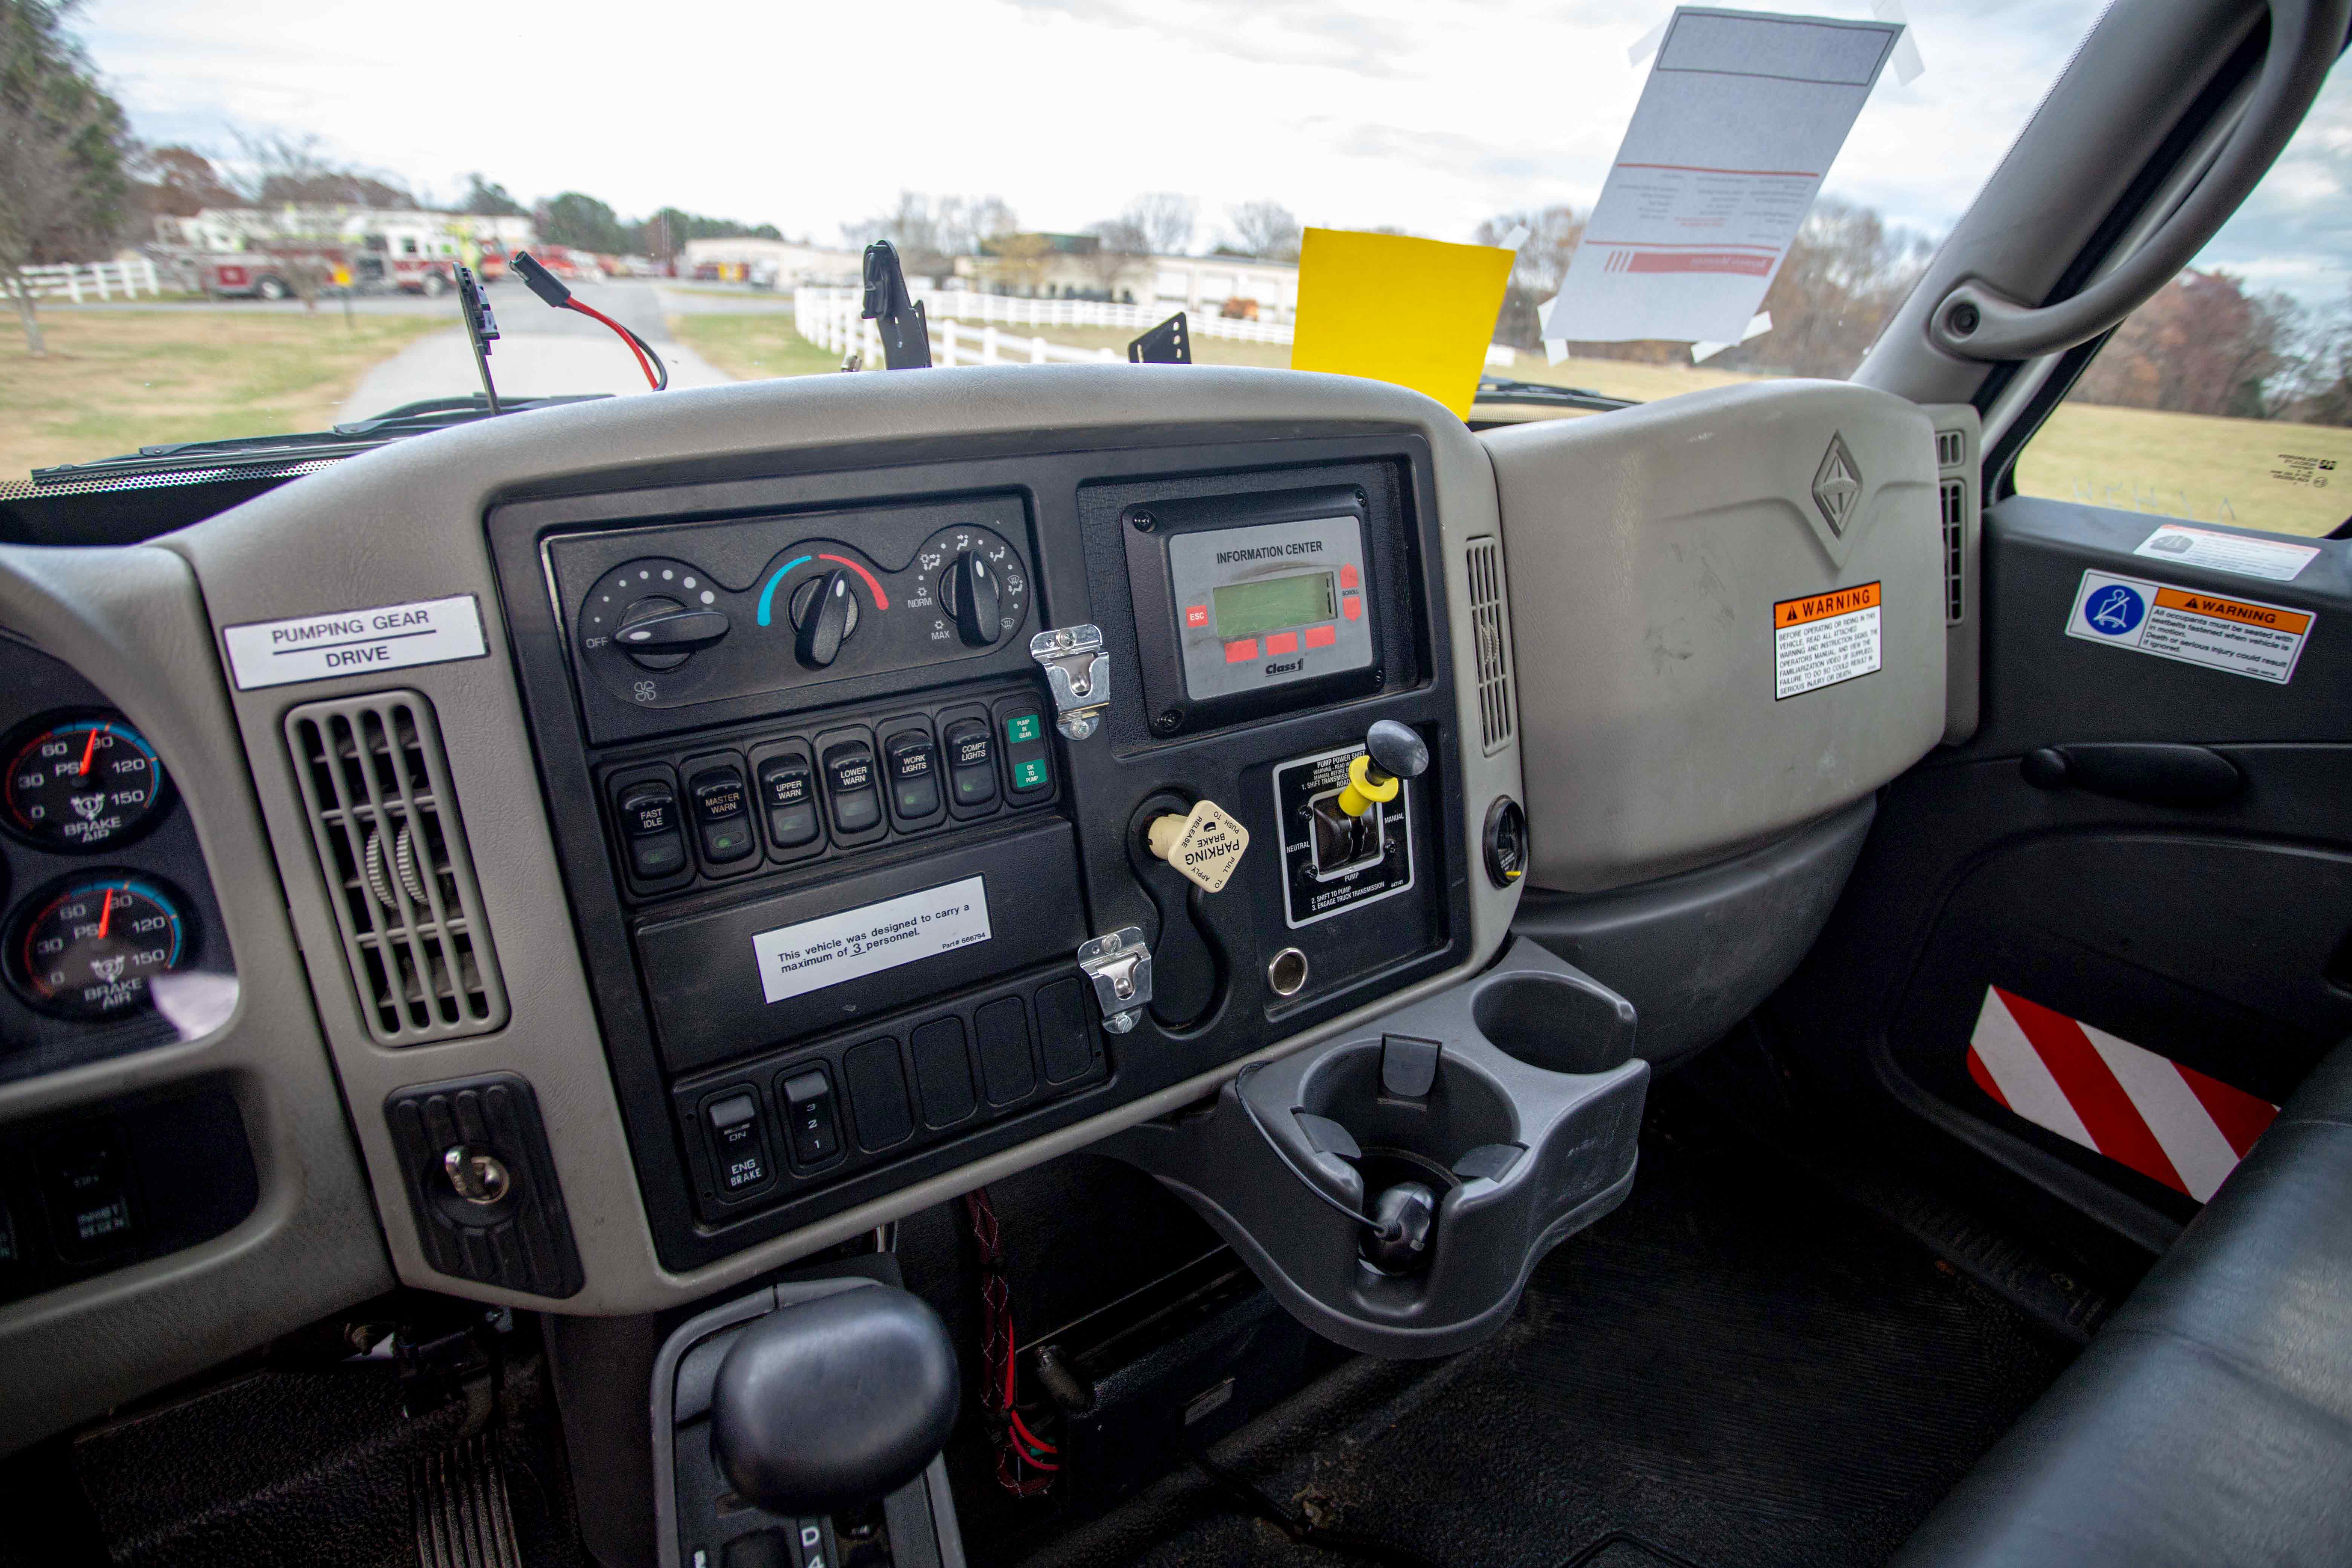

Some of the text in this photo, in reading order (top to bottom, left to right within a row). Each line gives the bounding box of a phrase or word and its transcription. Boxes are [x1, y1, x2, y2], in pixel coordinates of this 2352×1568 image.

[1217, 541, 1322, 564] INFORMATION CENTER
[908, 597, 932, 608] NORM
[1803, 589, 1870, 617] WARNING
[1190, 612, 1204, 620] ESC
[2203, 600, 2277, 623] WARNING
[272, 610, 429, 644] PUMPING GEAR
[1779, 630, 1801, 641] BEFORE
[1804, 623, 1833, 636] OPERATING
[1844, 616, 1858, 625] RIDING
[2151, 617, 2186, 629] seatbelts
[2188, 624, 2222, 637] fastened
[2225, 633, 2247, 642] when
[2249, 637, 2279, 649] vehicle
[2158, 626, 2186, 637] motion.
[2166, 612, 2207, 626] occupants
[2209, 621, 2230, 630] must
[2244, 628, 2273, 639] seated
[2275, 634, 2294, 643] with
[586, 637, 607, 648] OFF
[931, 630, 949, 640] MAX
[1807, 635, 1821, 644] READ
[1833, 626, 1857, 636] ATTACHED
[1779, 648, 1805, 659] WARNING
[1807, 643, 1818, 652] AND
[1820, 635, 1852, 649] INSTRUCTION
[2145, 631, 2168, 642] Death
[2180, 640, 2209, 651] serious
[2211, 646, 2235, 658] injury
[2236, 652, 2260, 663] could
[2262, 657, 2288, 668] result
[2150, 641, 2181, 652] ignored.
[326, 646, 390, 668] DRIVE
[1779, 660, 1825, 677] FAMILIARIZATION
[1826, 655, 1841, 665] VIDEO
[1779, 675, 1802, 686] FAILURE
[1832, 662, 1848, 672] COULD
[1850, 657, 1867, 666] RESULT
[1780, 683, 1804, 695] SERIOUS
[1807, 677, 1825, 688] INJURY
[42, 742, 68, 756] 60
[962, 742, 986, 753] COMPT
[903, 754, 925, 765] WORK
[962, 750, 986, 761] LIGHTS
[1317, 759, 1332, 769] PUMP
[1333, 755, 1351, 765] POWER
[113, 759, 146, 773] 120
[841, 766, 867, 778] LOWER
[902, 763, 926, 773] LIGHTS
[1313, 766, 1332, 775] WARNING
[18, 773, 44, 789] 30
[776, 781, 802, 792] UPPER
[843, 775, 865, 786] WARN
[1307, 780, 1320, 789] SHIFT
[111, 790, 145, 805] 150
[706, 793, 740, 807] MASTER
[778, 789, 801, 799] WARN
[31, 805, 45, 819] 0
[641, 808, 662, 820] FAST
[711, 802, 736, 814] WARN
[643, 818, 663, 828] IDLE
[1384, 813, 1404, 824] MANUAL
[64, 816, 122, 837] BRAKE
[1182, 811, 1240, 848] PUSH TO RELEASE
[83, 829, 110, 843] AIR
[1197, 833, 1225, 848] BRAKE
[1185, 839, 1240, 865] PARKING
[1286, 841, 1310, 853] NEUTRAL
[1191, 856, 1235, 888] PULL TO APPLY
[1344, 872, 1359, 882] PUMP
[1317, 891, 1330, 903] SHIFT
[1338, 886, 1351, 896] PUMP
[1317, 898, 1336, 909] ENGAGE
[1337, 893, 1352, 904] TRUCK
[1352, 881, 1384, 900] TRANSMISSION
[132, 916, 165, 933] 120
[778, 951, 800, 963] This
[805, 939, 842, 955] vehicle
[846, 933, 867, 944] was
[871, 917, 917, 938] designed
[921, 914, 931, 923] to
[935, 906, 960, 920] carry
[942, 932, 986, 950] Part# 666794
[132, 949, 165, 966] 150
[781, 928, 920, 974] maximum of 3 personnel.
[51, 971, 65, 986] 0
[83, 977, 142, 1002] BRAKE
[103, 992, 132, 1010] AIR
[807, 1103, 816, 1112] 3
[808, 1119, 817, 1130] 2
[729, 1131, 746, 1141] ON
[814, 1140, 820, 1149] 1
[731, 1159, 755, 1175] ENG
[730, 1168, 762, 1187] BRAKE
[801, 1526, 819, 1547] D
